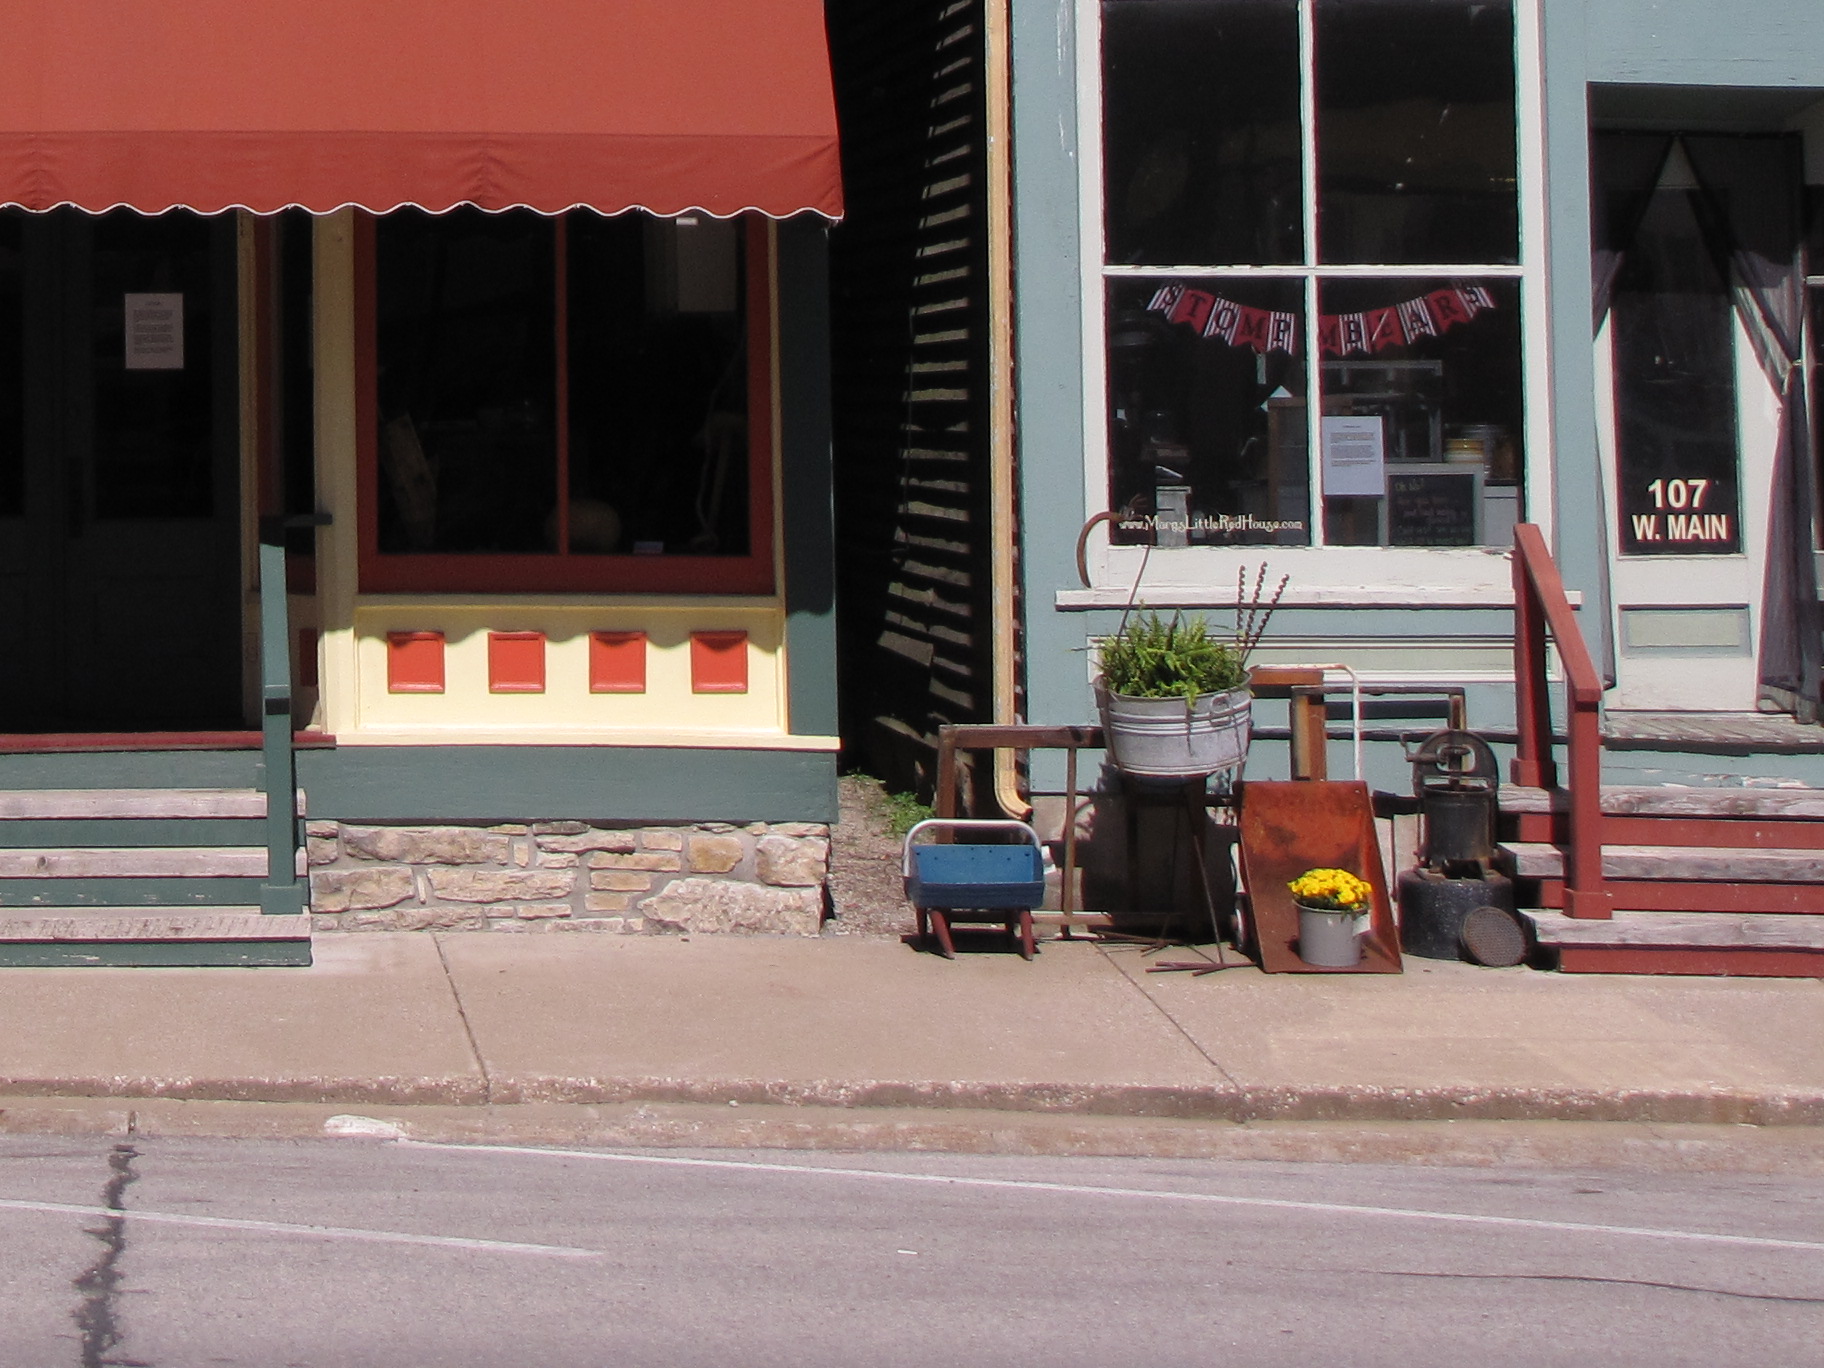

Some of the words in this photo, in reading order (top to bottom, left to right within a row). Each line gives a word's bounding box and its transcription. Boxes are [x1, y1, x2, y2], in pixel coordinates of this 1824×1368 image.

[1647, 478, 1708, 509] 107
[1631, 514, 1661, 540] W.
[1667, 514, 1728, 540] MAIN
